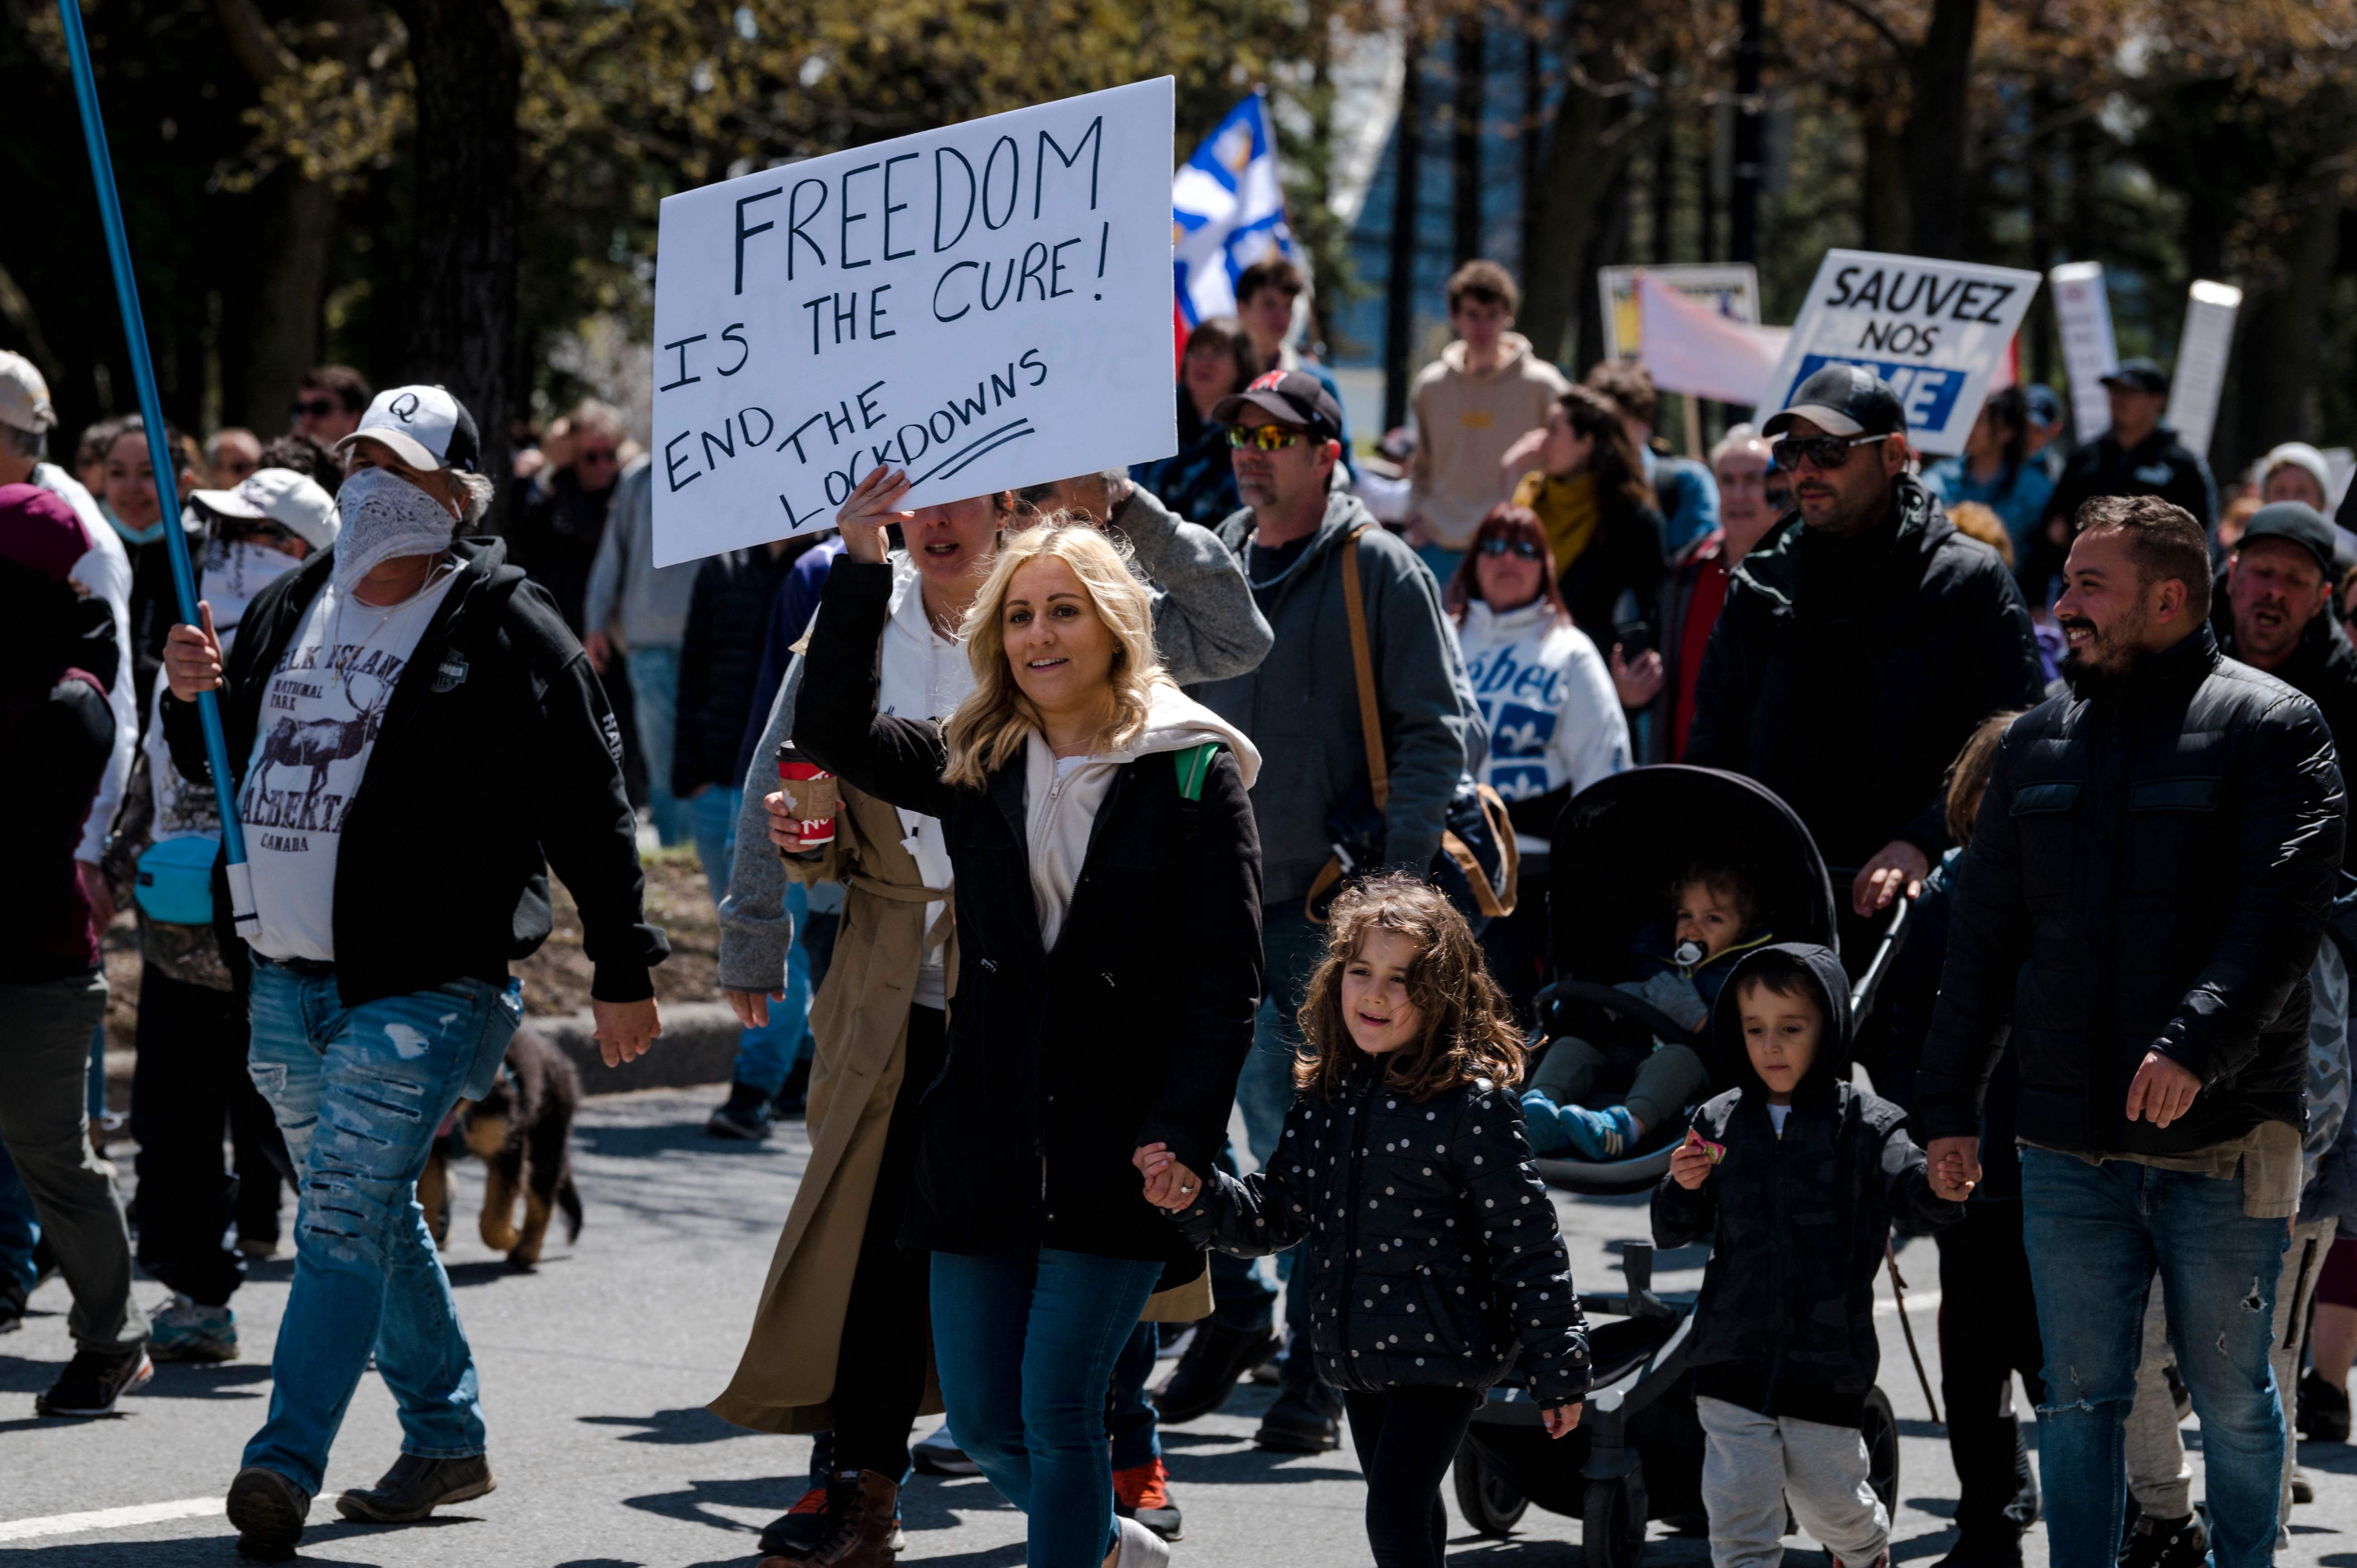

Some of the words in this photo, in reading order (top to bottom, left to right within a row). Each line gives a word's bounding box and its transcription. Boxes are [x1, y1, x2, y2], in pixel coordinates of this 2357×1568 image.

[735, 115, 1103, 295] FREEDOM
[1826, 266, 2016, 325] SAUVEZ
[660, 323, 748, 392] IS
[803, 284, 897, 356] THE
[1858, 319, 1940, 356] NOS
[389, 393, 419, 423] Q
[665, 407, 774, 492] END
[776, 380, 887, 464] THE
[779, 348, 1047, 529] LOCKDOWNS
[273, 645, 323, 675] ELK
[270, 694, 297, 711] PARK
[272, 679, 323, 699] NATIONAL
[260, 832, 309, 852] CANADA
